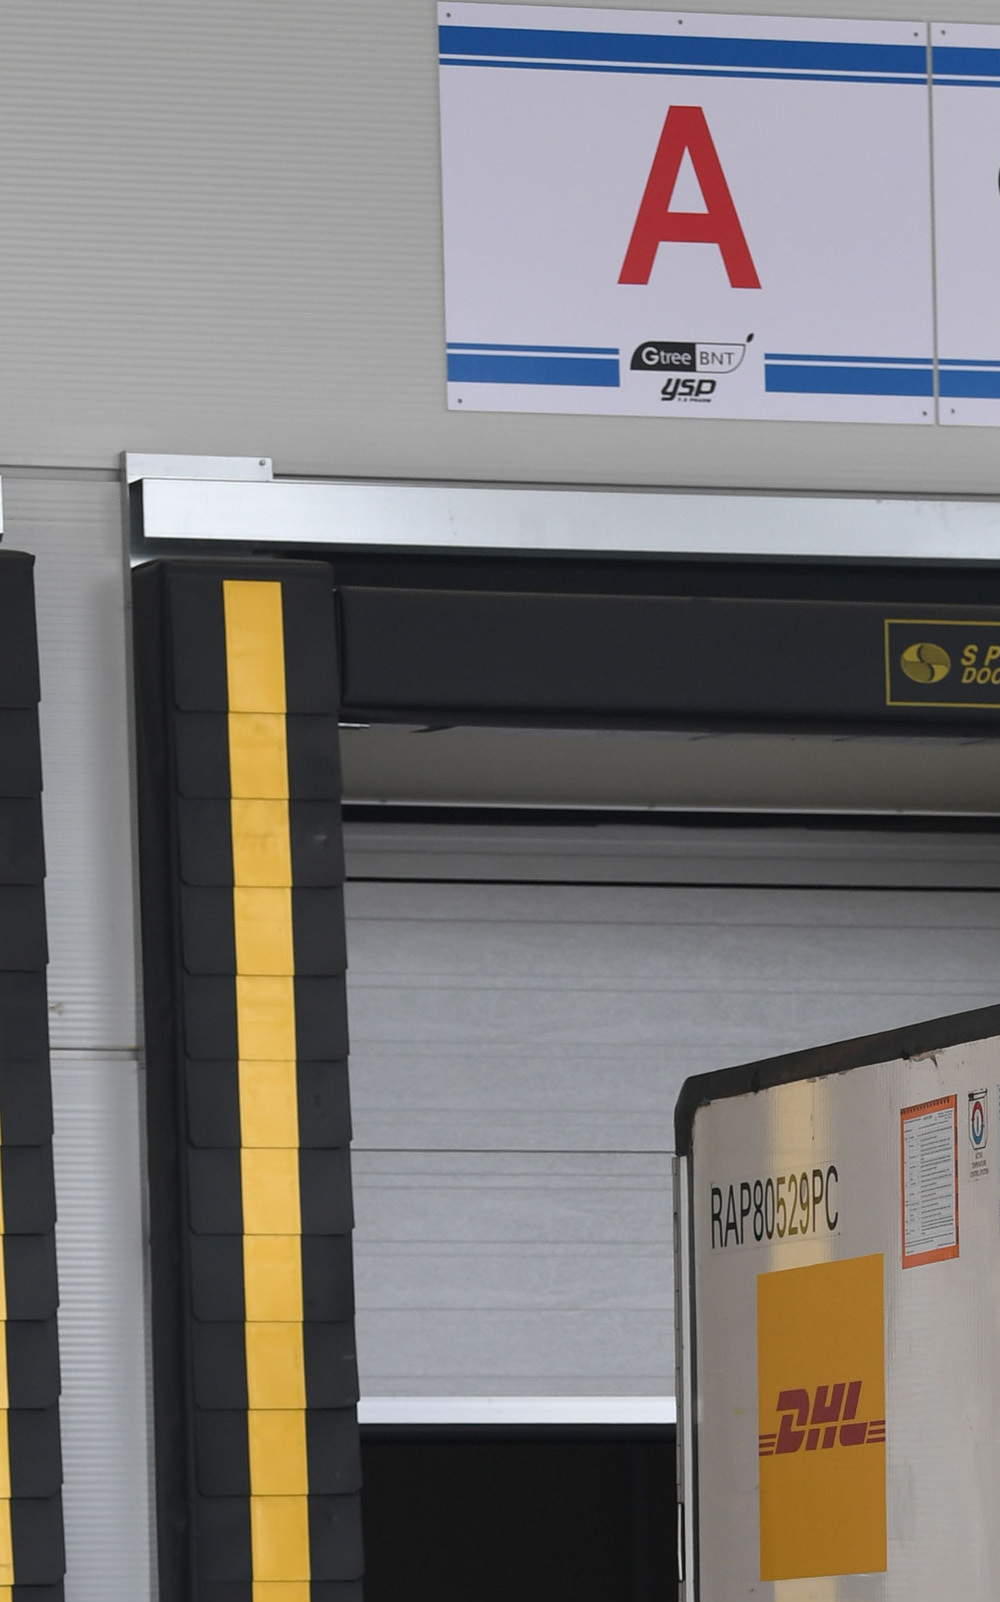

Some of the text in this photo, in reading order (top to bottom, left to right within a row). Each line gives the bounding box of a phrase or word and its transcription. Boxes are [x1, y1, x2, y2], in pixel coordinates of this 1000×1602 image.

[617, 105, 762, 290] A
[711, 1165, 839, 1249] RAP80529PC
[775, 1380, 867, 1455] DHL
